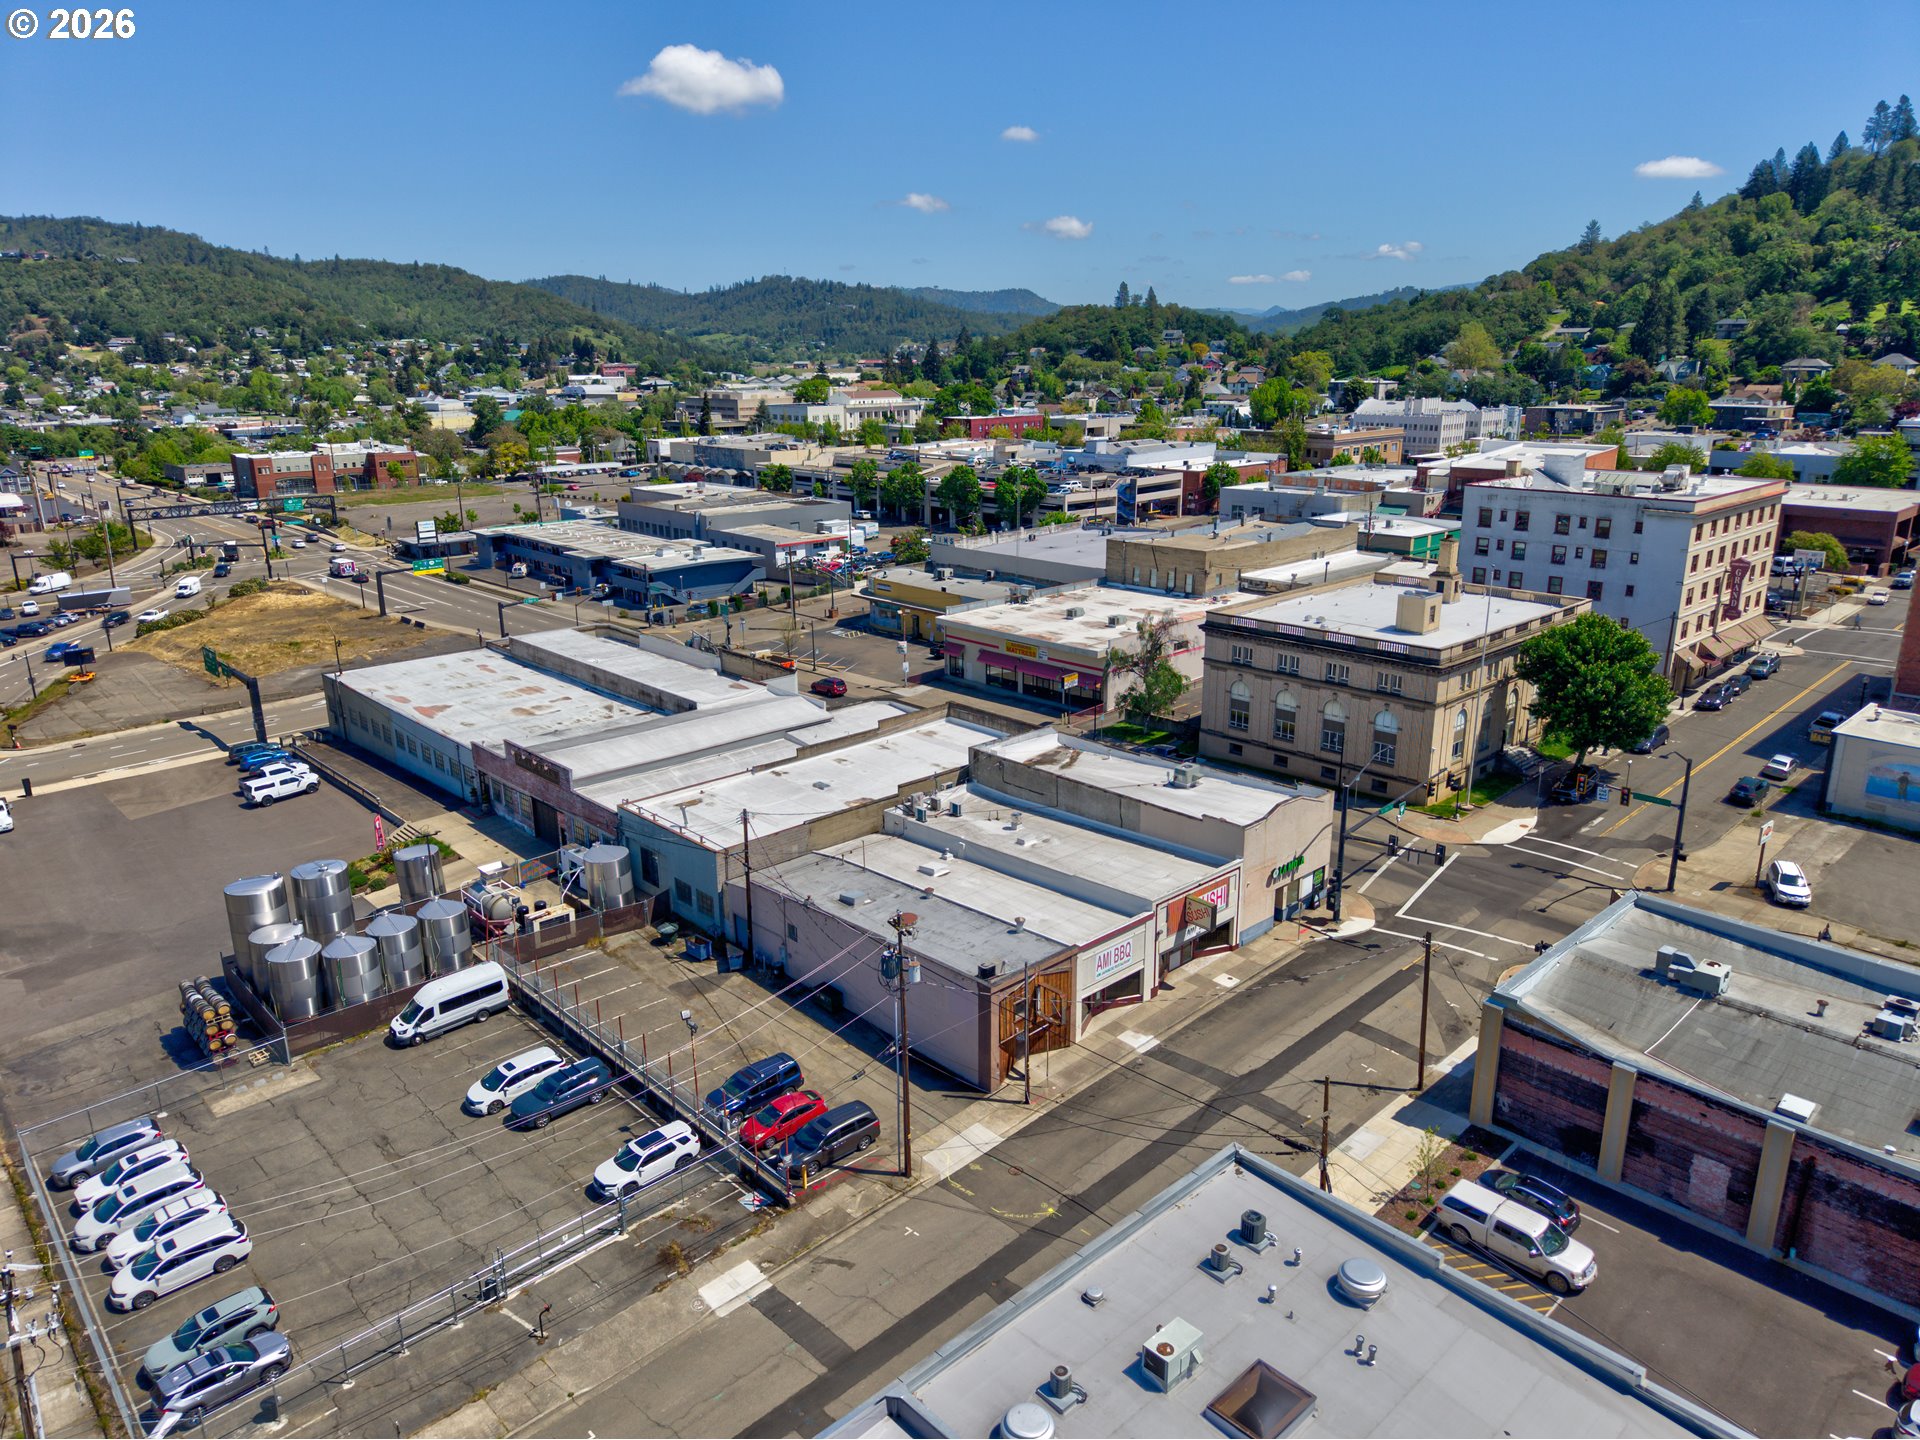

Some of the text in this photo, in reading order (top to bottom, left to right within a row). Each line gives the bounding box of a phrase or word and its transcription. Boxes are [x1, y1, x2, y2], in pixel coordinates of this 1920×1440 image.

[1731, 568, 1741, 606] GRAND
[1186, 907, 1210, 922] SUSHI
[1096, 950, 1112, 972] AMI
[1113, 941, 1132, 964] BBQ
